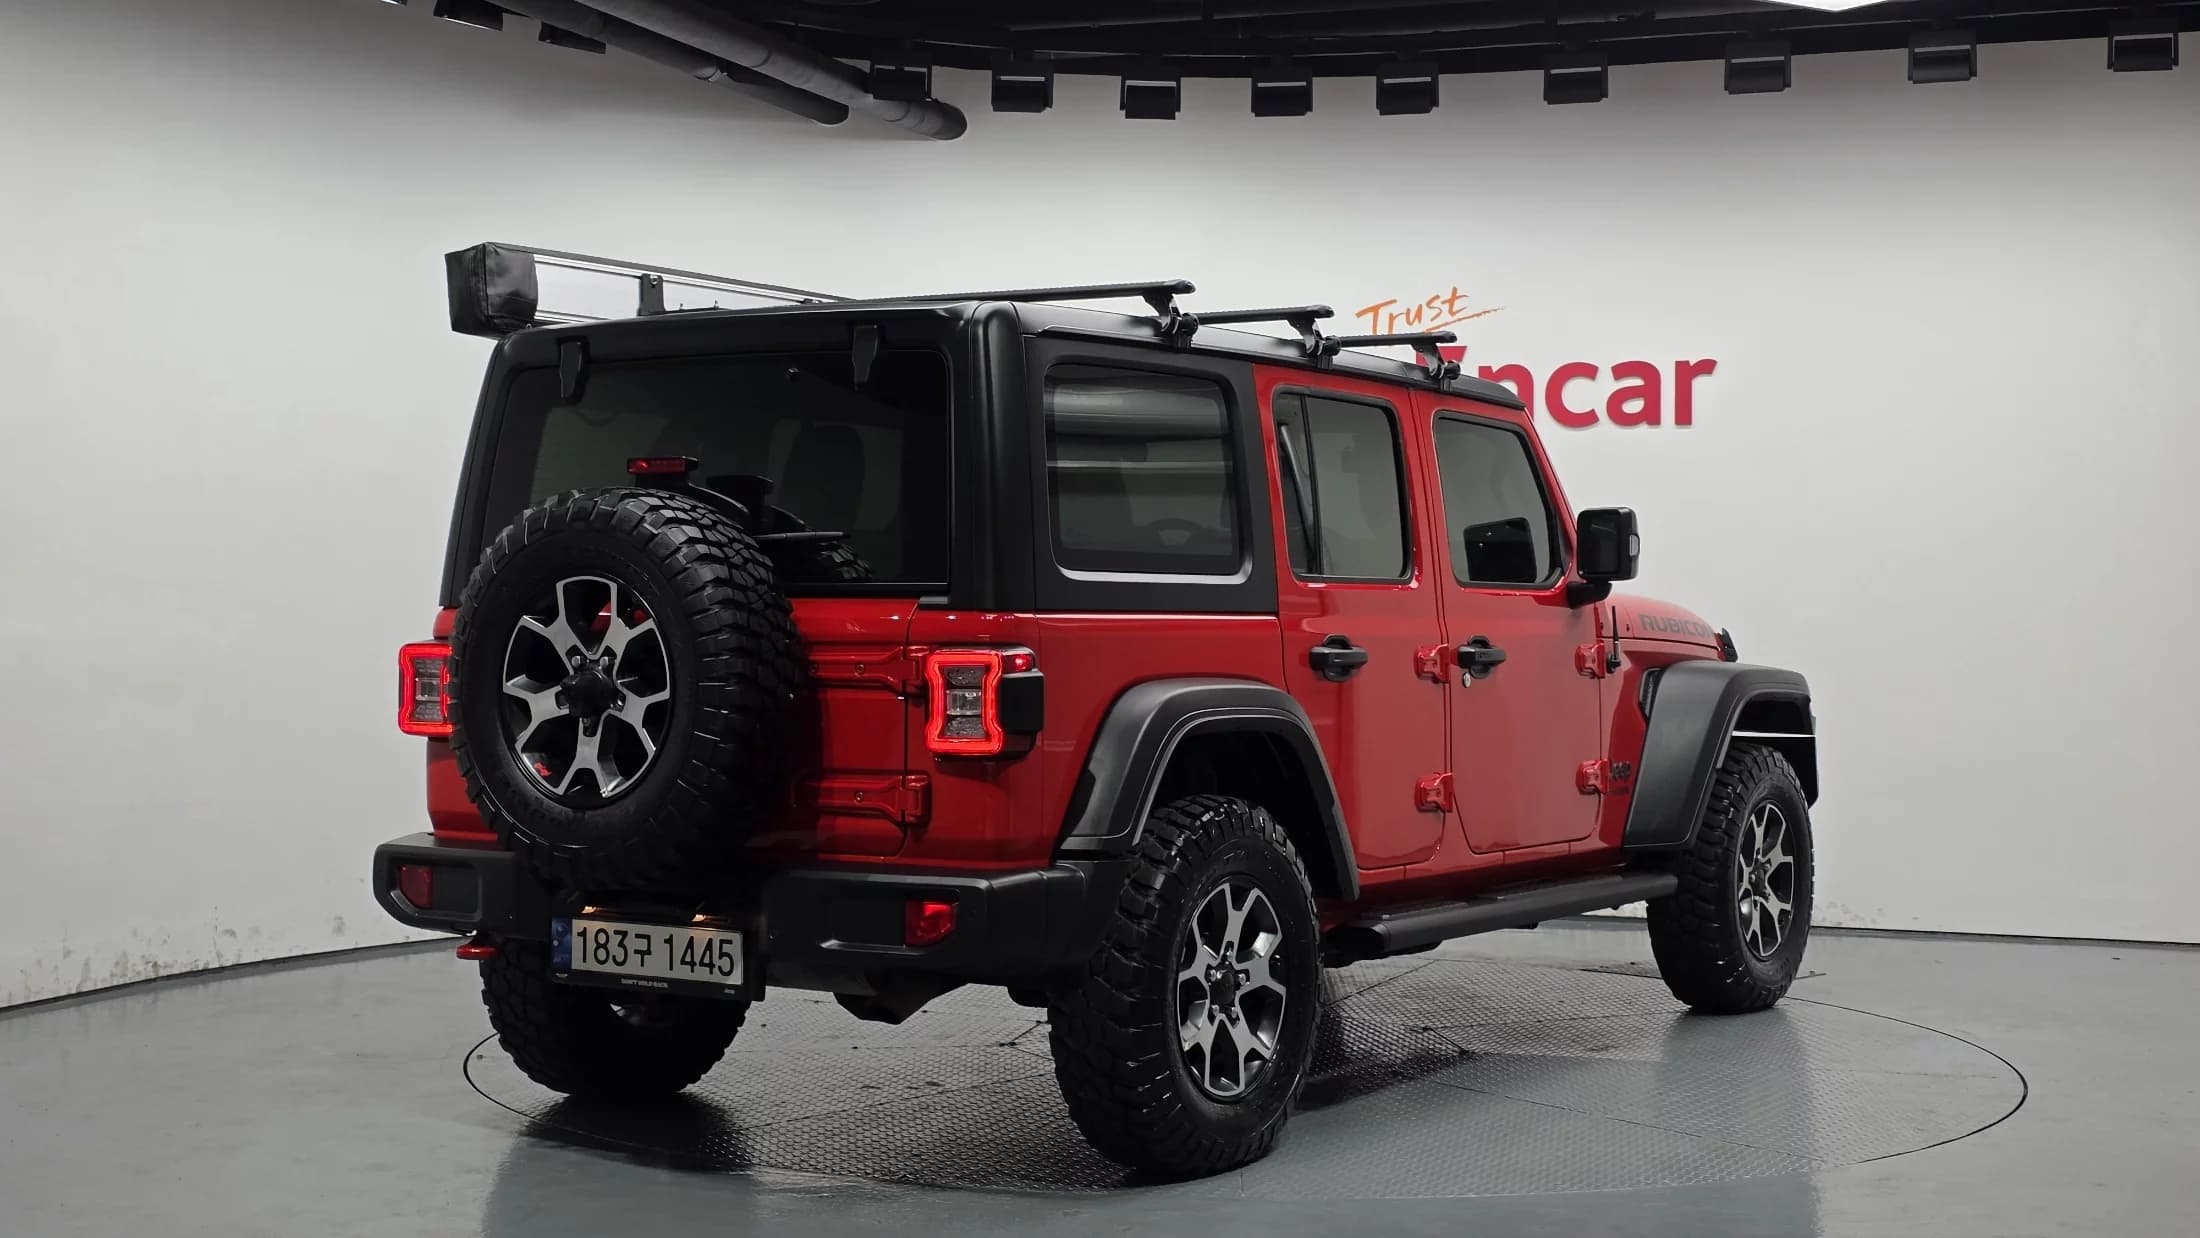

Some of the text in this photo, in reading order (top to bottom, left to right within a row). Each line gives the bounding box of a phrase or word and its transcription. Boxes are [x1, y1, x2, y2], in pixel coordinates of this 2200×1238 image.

[1355, 286, 1470, 337] Trust
[1415, 345, 1718, 428] ncar
[576, 926, 735, 977] 183구 1445
